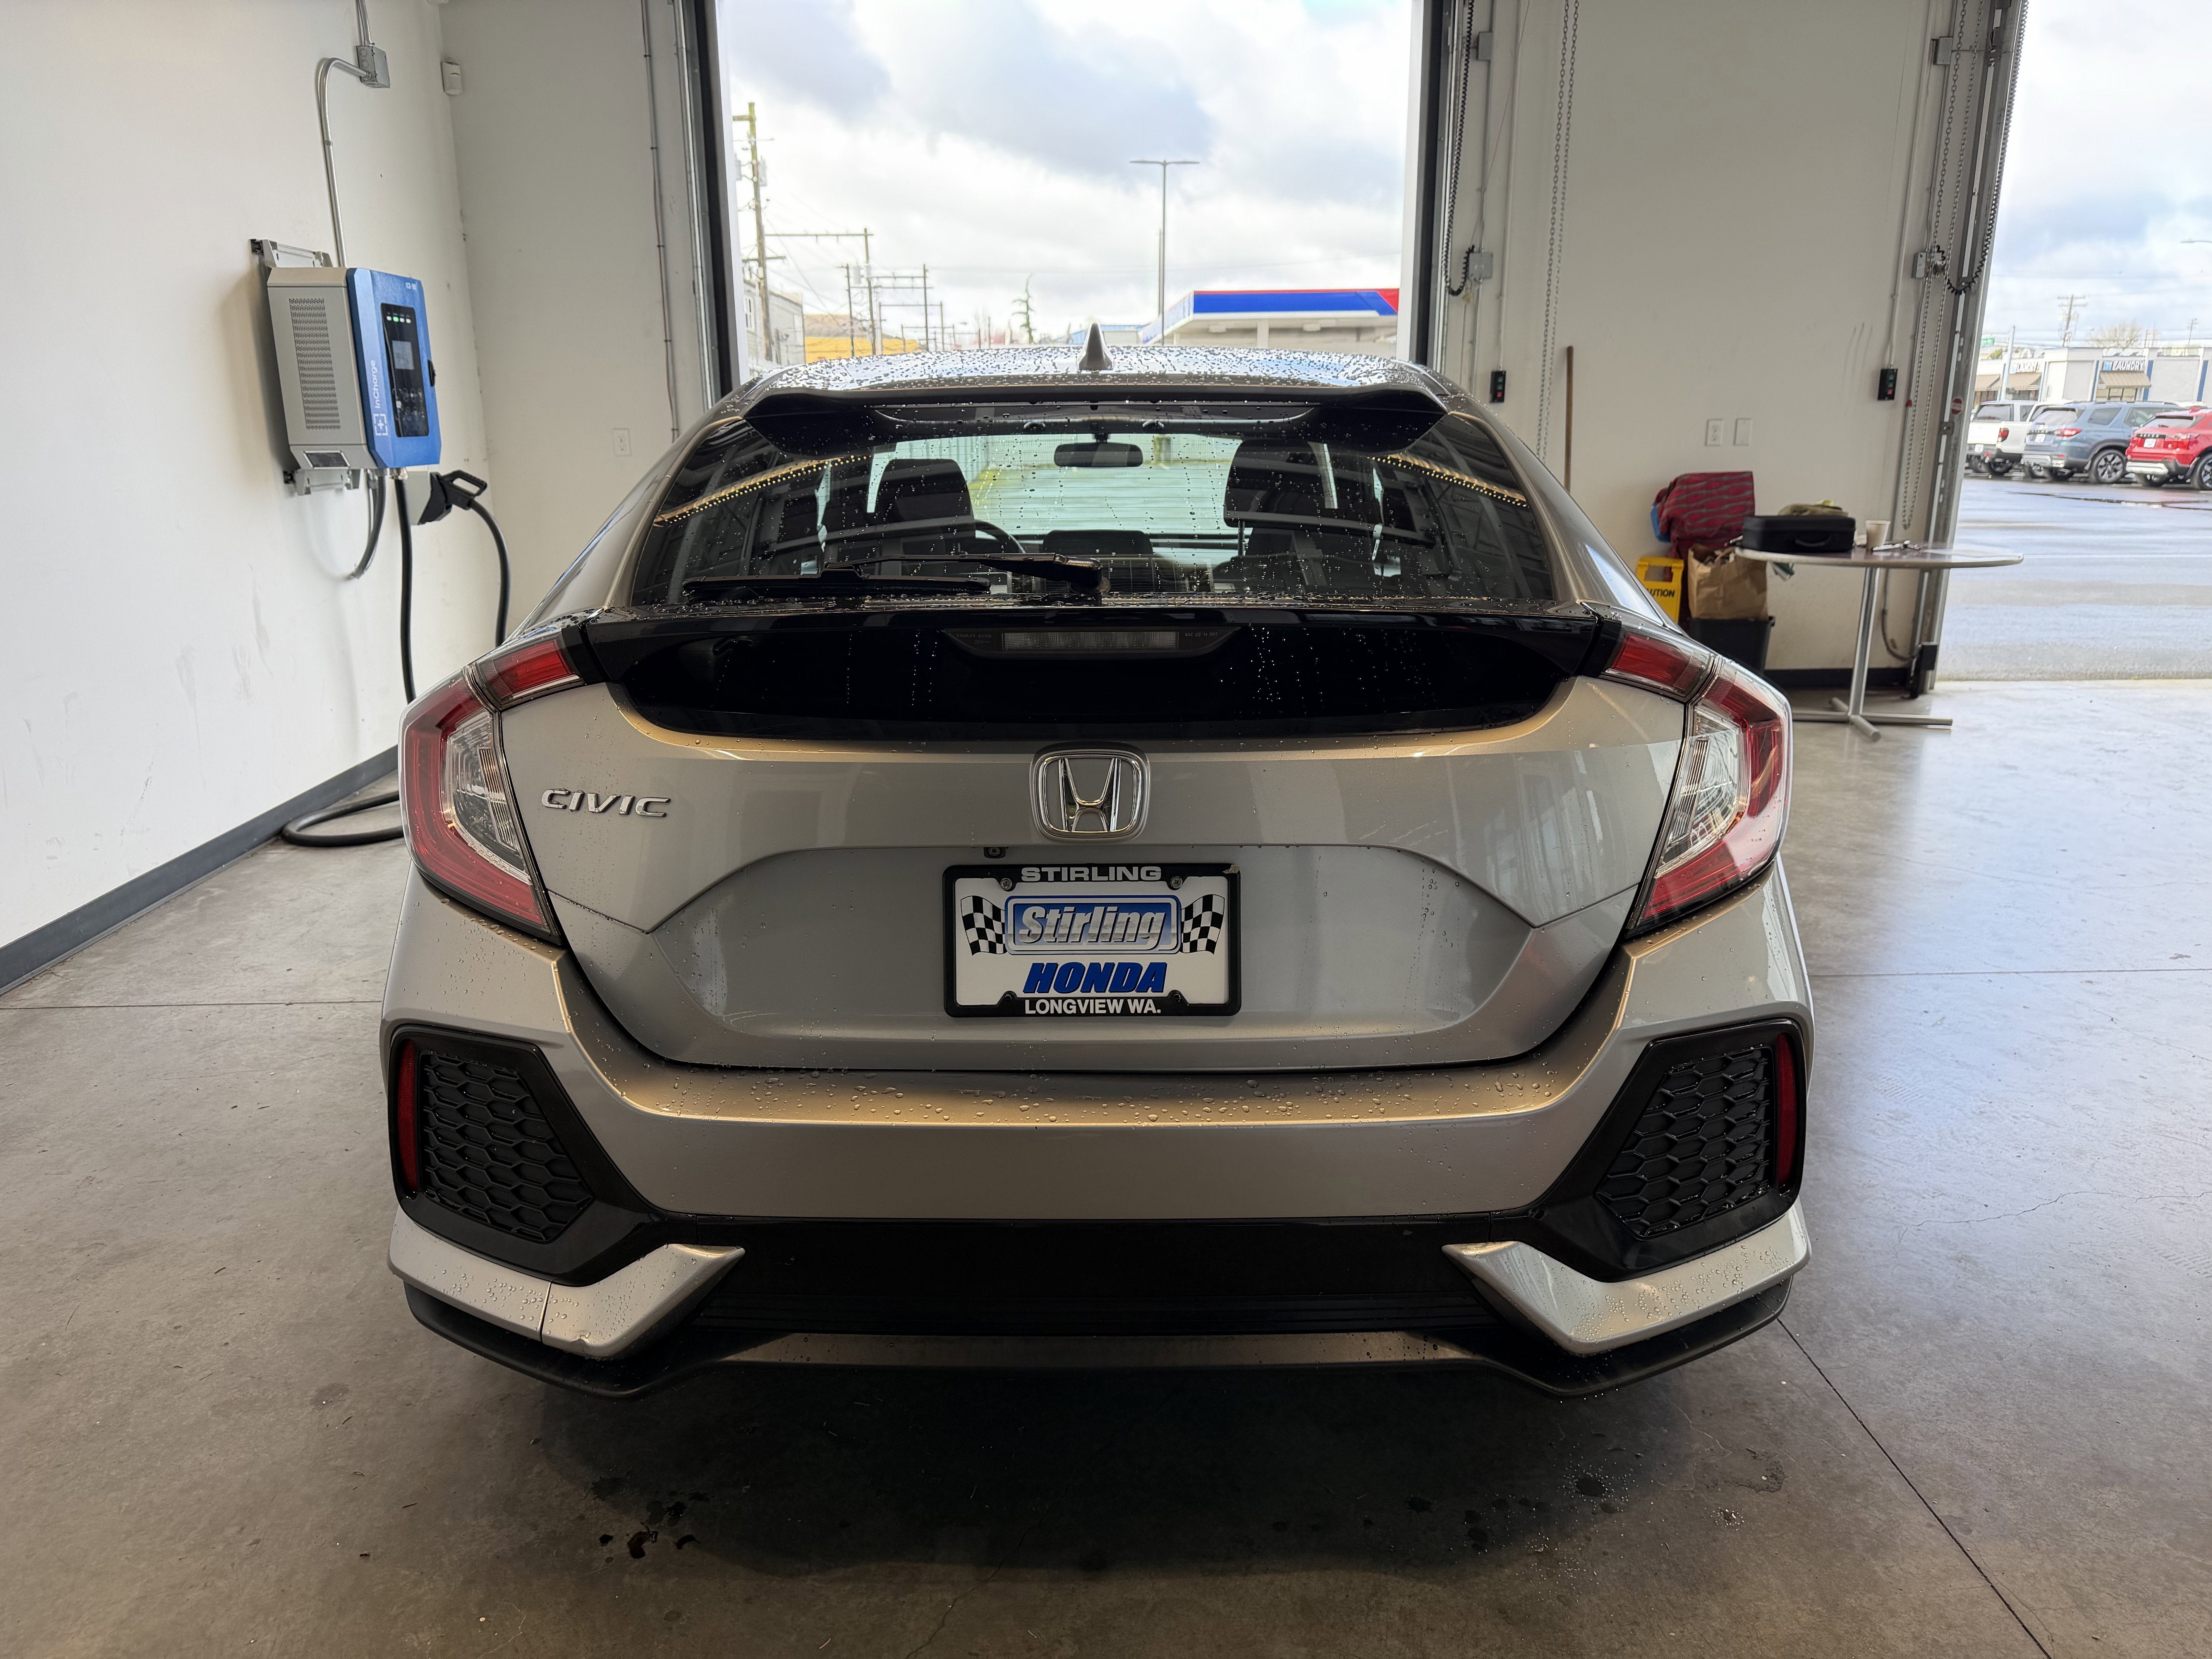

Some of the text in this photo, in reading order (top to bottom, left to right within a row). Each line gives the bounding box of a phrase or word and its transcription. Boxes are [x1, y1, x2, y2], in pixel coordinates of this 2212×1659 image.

[2112, 360, 2144, 371] LAUNDRY
[371, 360, 380, 409] InCharge
[1647, 588, 1675, 597] UTION
[541, 788, 671, 817] CIVIC
[1021, 866, 1161, 882] STIRLING
[1018, 906, 1166, 949] Stirling
[1022, 962, 1168, 994] HONDA
[1025, 999, 1161, 1014] LONGVIEW WA.
